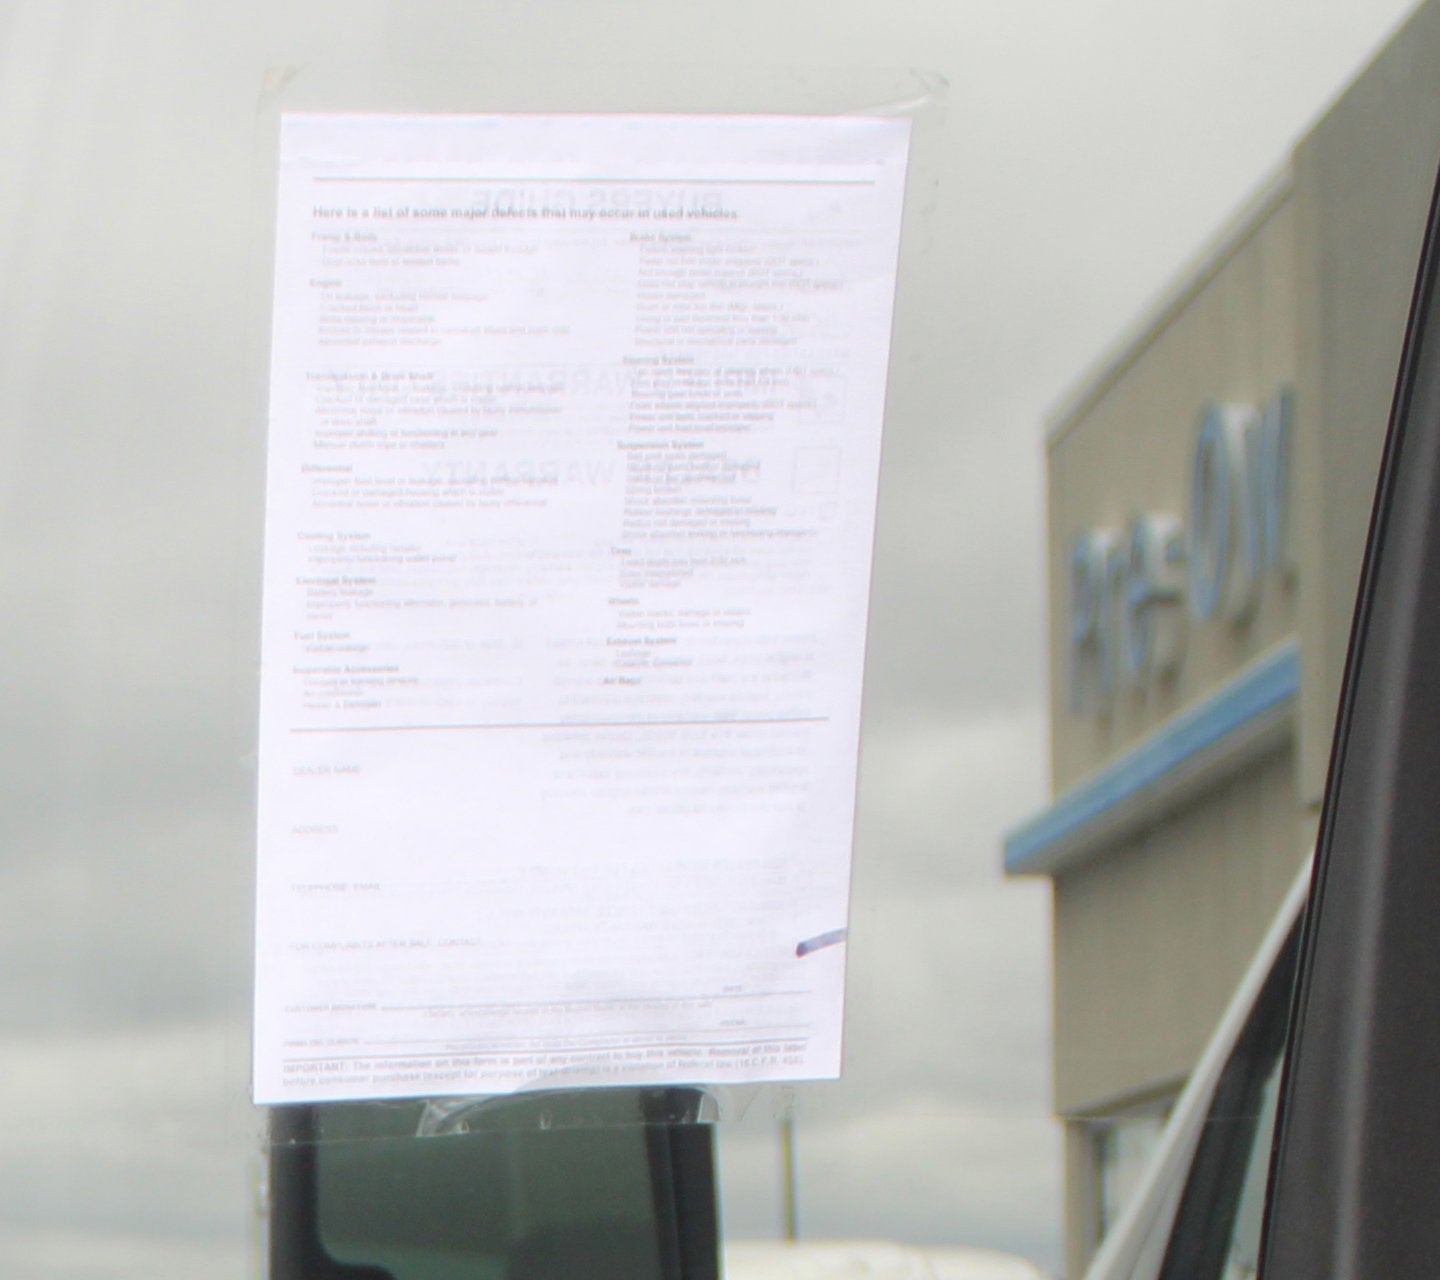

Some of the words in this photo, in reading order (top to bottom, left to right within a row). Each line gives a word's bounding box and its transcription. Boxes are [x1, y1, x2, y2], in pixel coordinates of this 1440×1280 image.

[313, 206, 342, 218] Here
[373, 206, 393, 218] list
[396, 206, 409, 218] of
[413, 206, 447, 218] some
[451, 206, 487, 220] major
[491, 207, 537, 218] defects
[542, 207, 566, 218] that
[570, 207, 595, 221] may
[599, 207, 633, 219] occur
[638, 207, 650, 219] in
[654, 207, 682, 219] used
[354, 1061, 372, 1071] The
